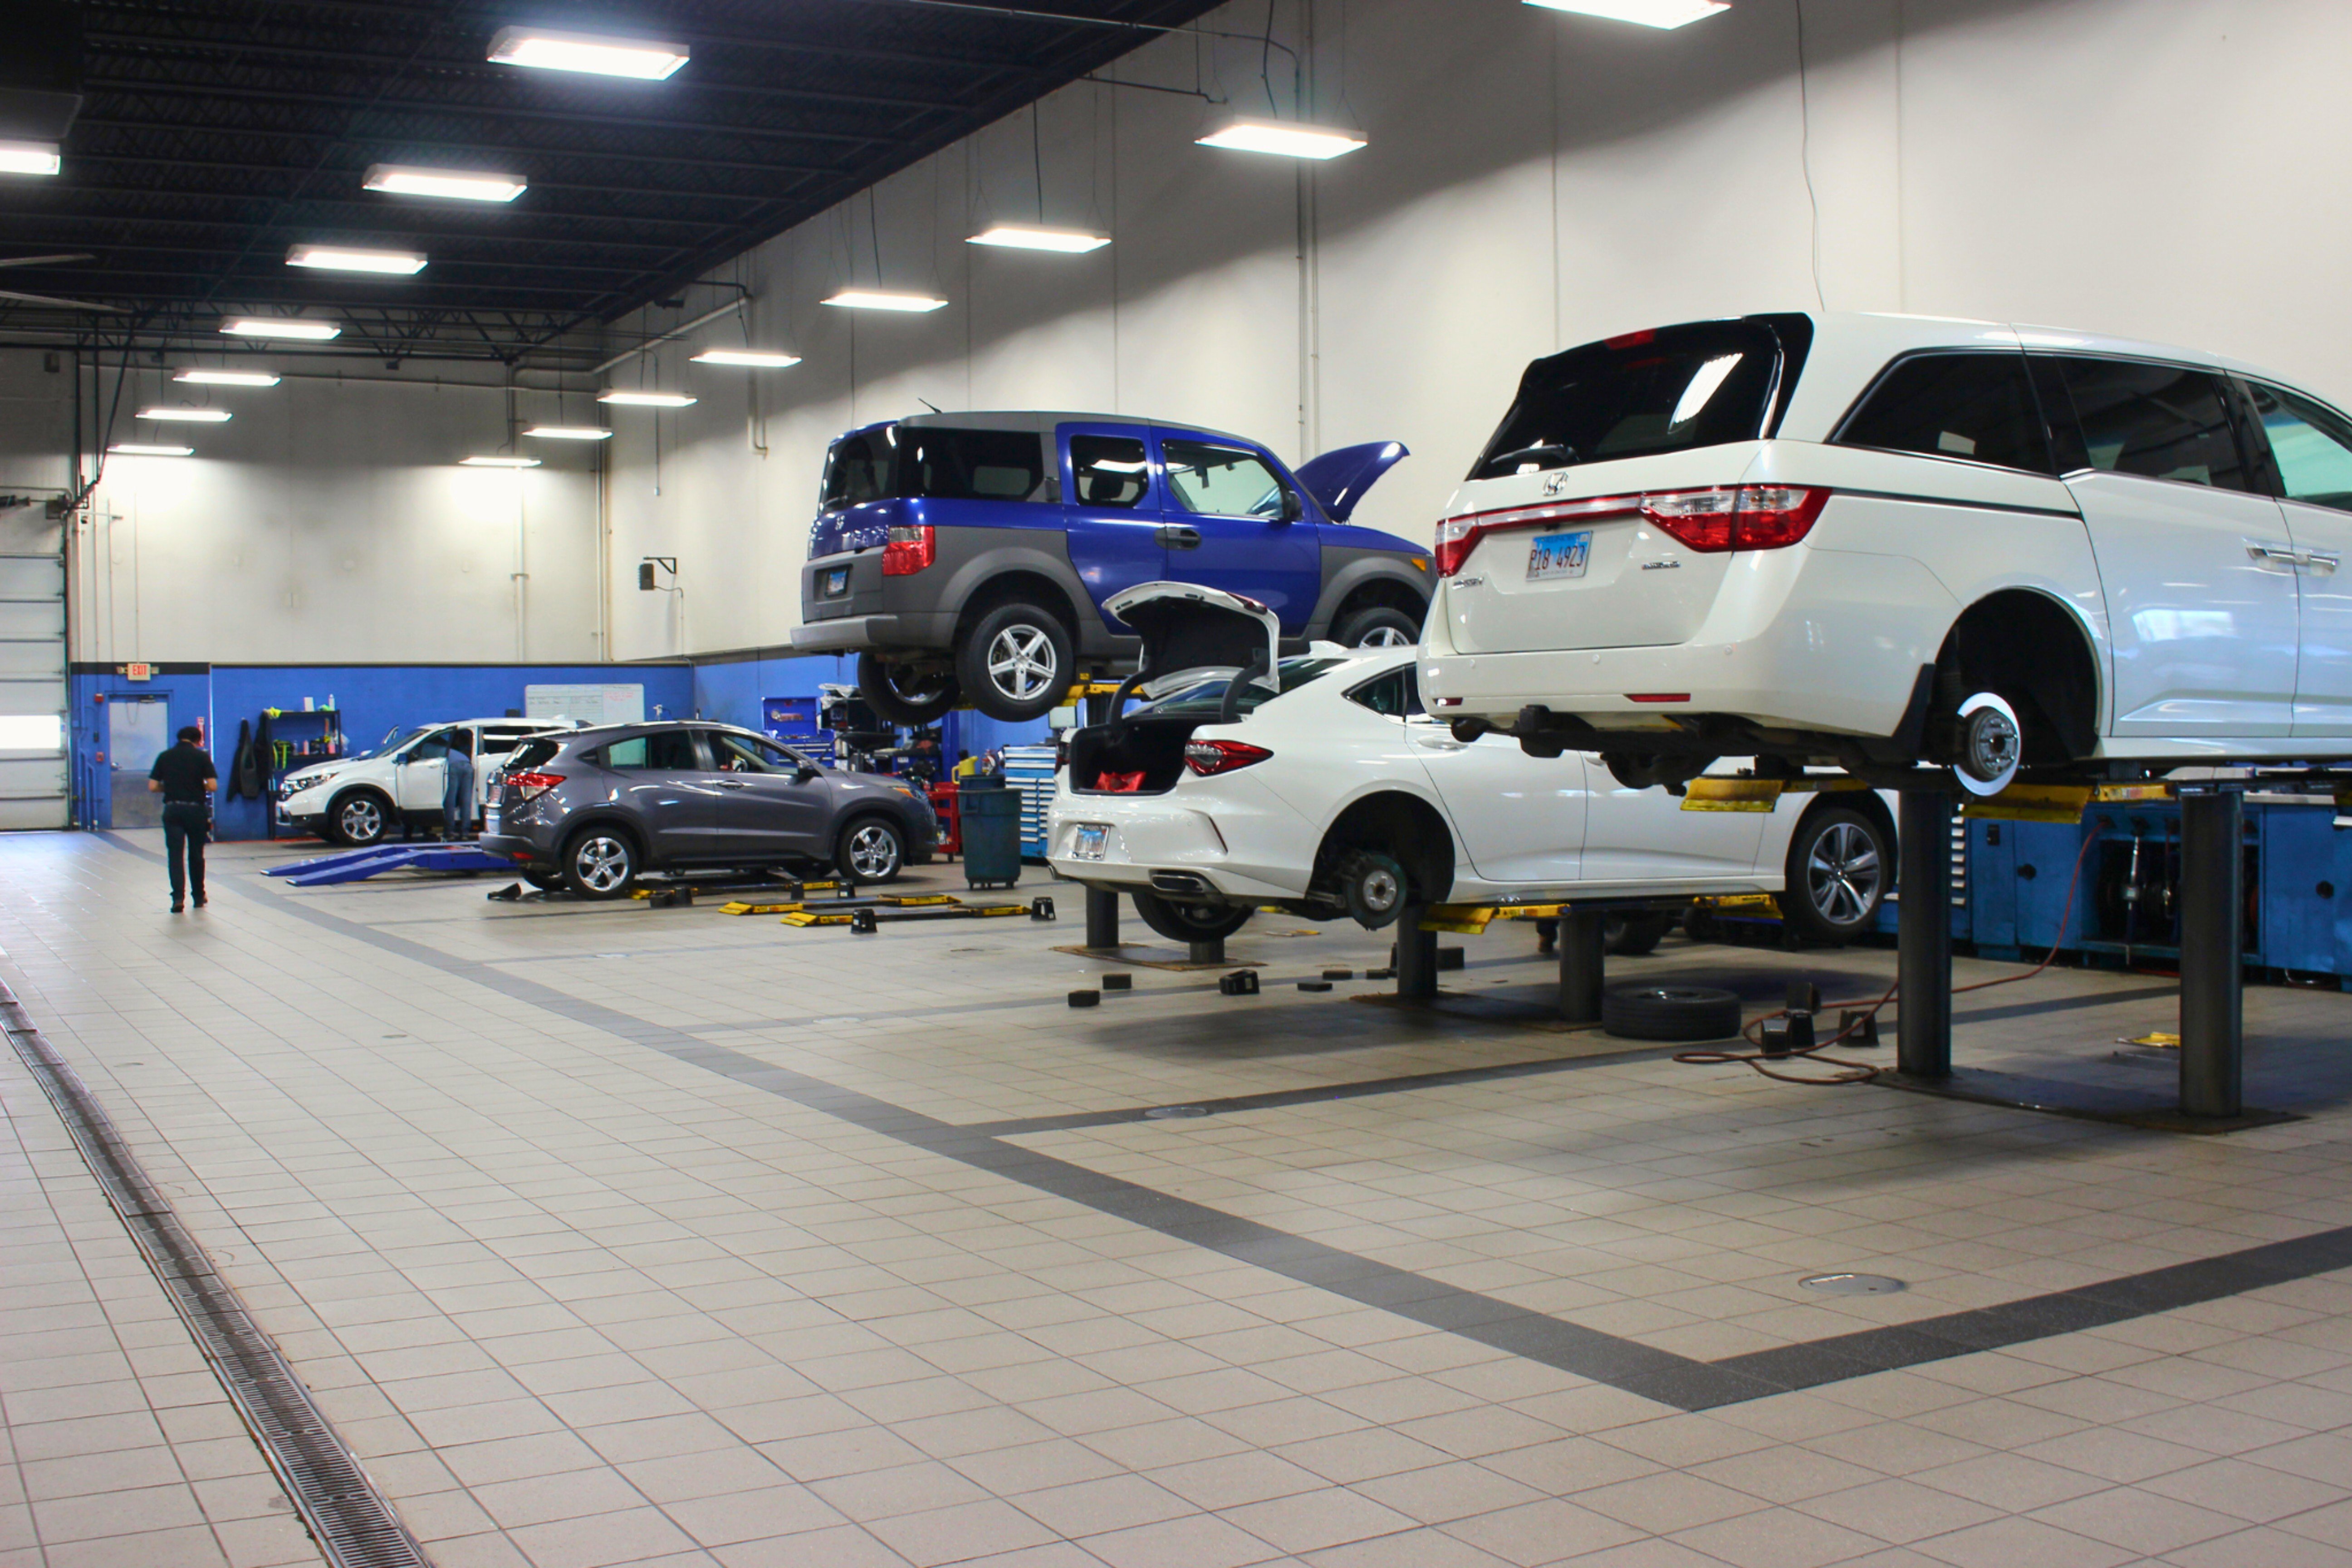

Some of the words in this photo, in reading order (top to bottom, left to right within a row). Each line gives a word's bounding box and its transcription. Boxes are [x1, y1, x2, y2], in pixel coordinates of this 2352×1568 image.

[1529, 548, 1551, 570] P18
[1556, 545, 1586, 568] 4923
[132, 665, 147, 676] EXIT
